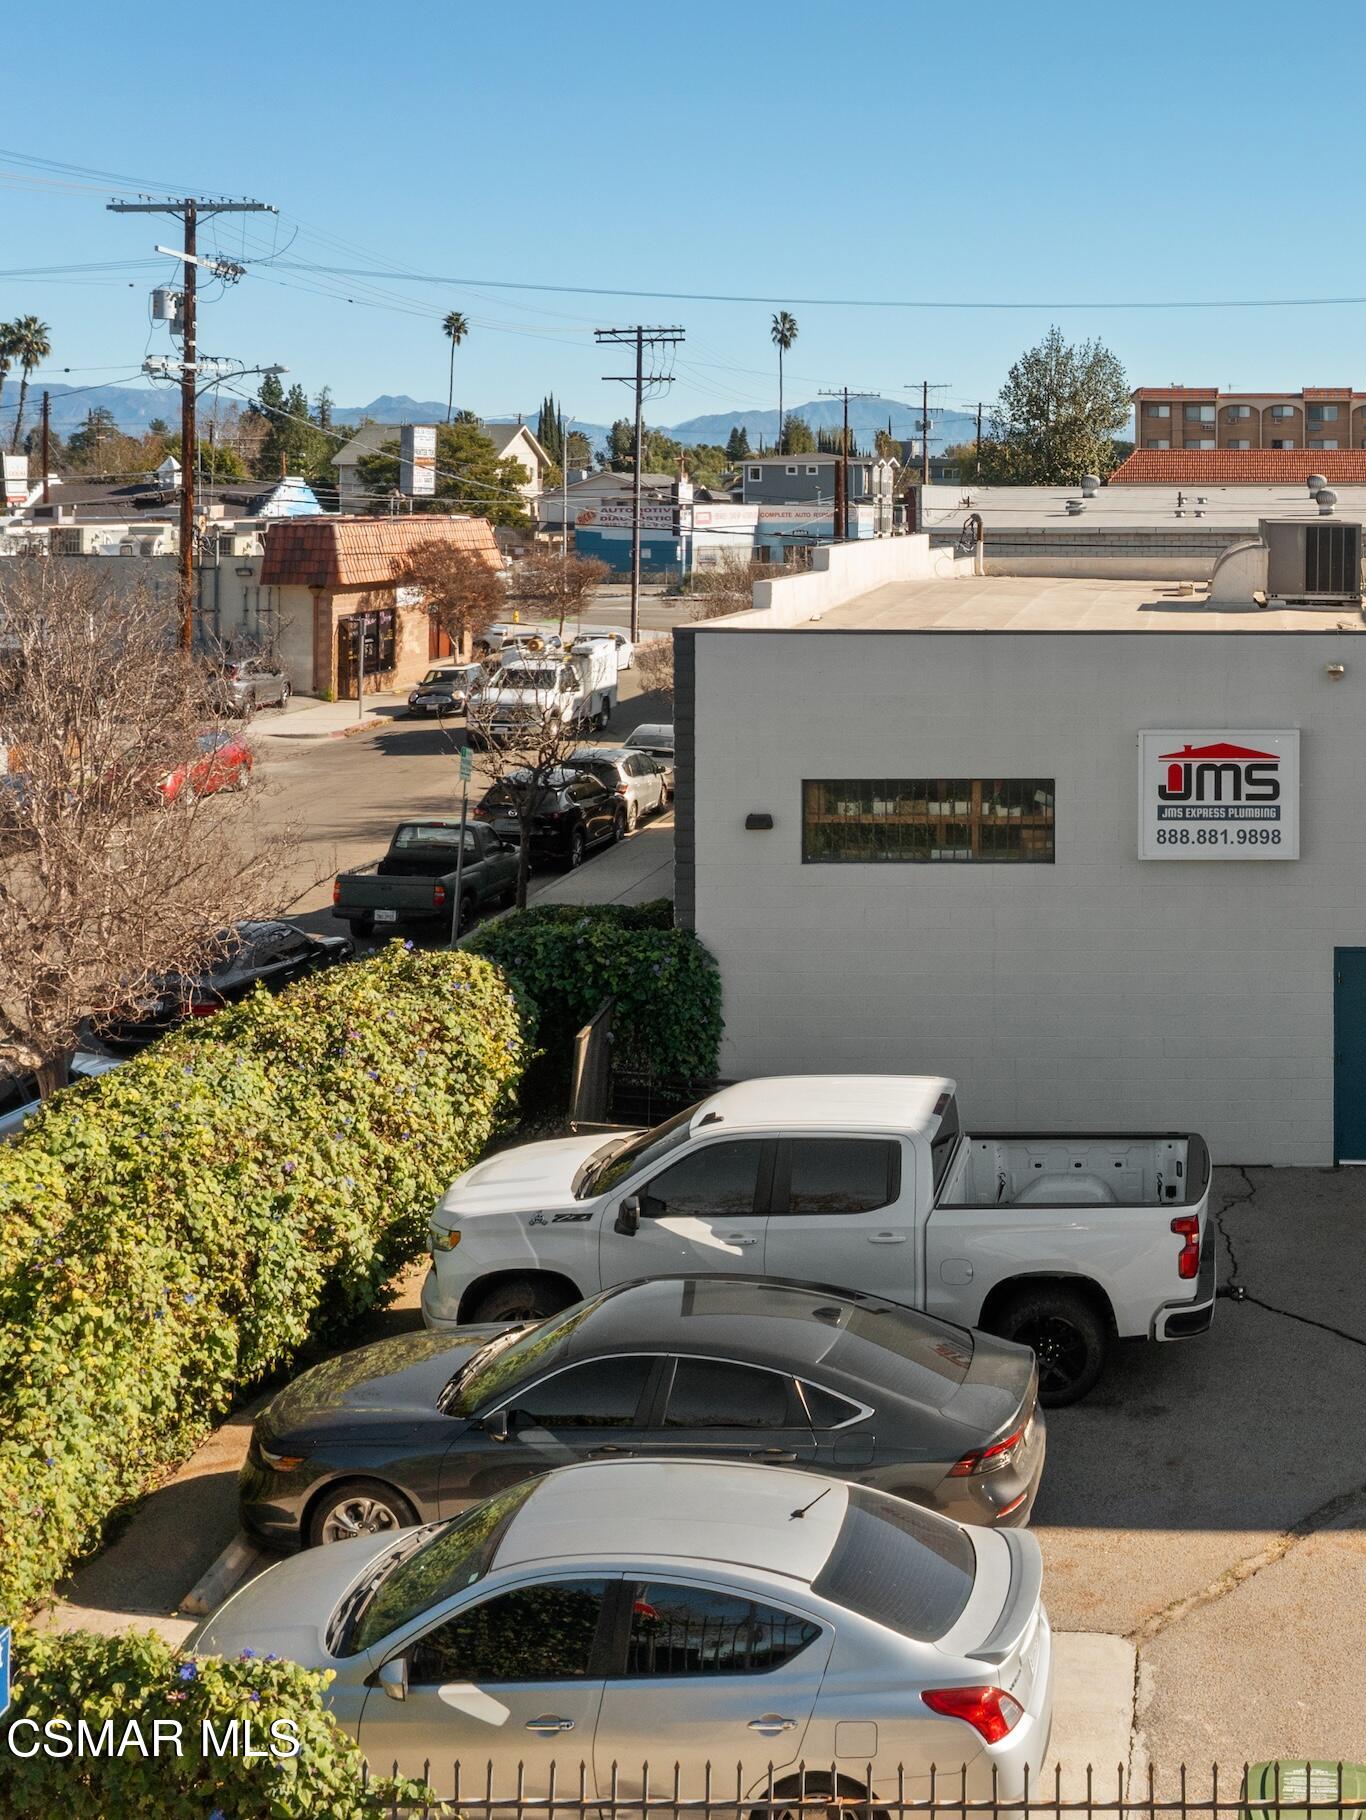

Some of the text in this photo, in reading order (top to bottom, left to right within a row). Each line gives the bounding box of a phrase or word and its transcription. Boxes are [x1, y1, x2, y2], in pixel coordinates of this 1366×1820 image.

[1158, 763, 1280, 801] JMS
[1162, 807, 1276, 818] JMS EXPRESS PLUMBING
[1156, 829, 1281, 845] 888.881.9898
